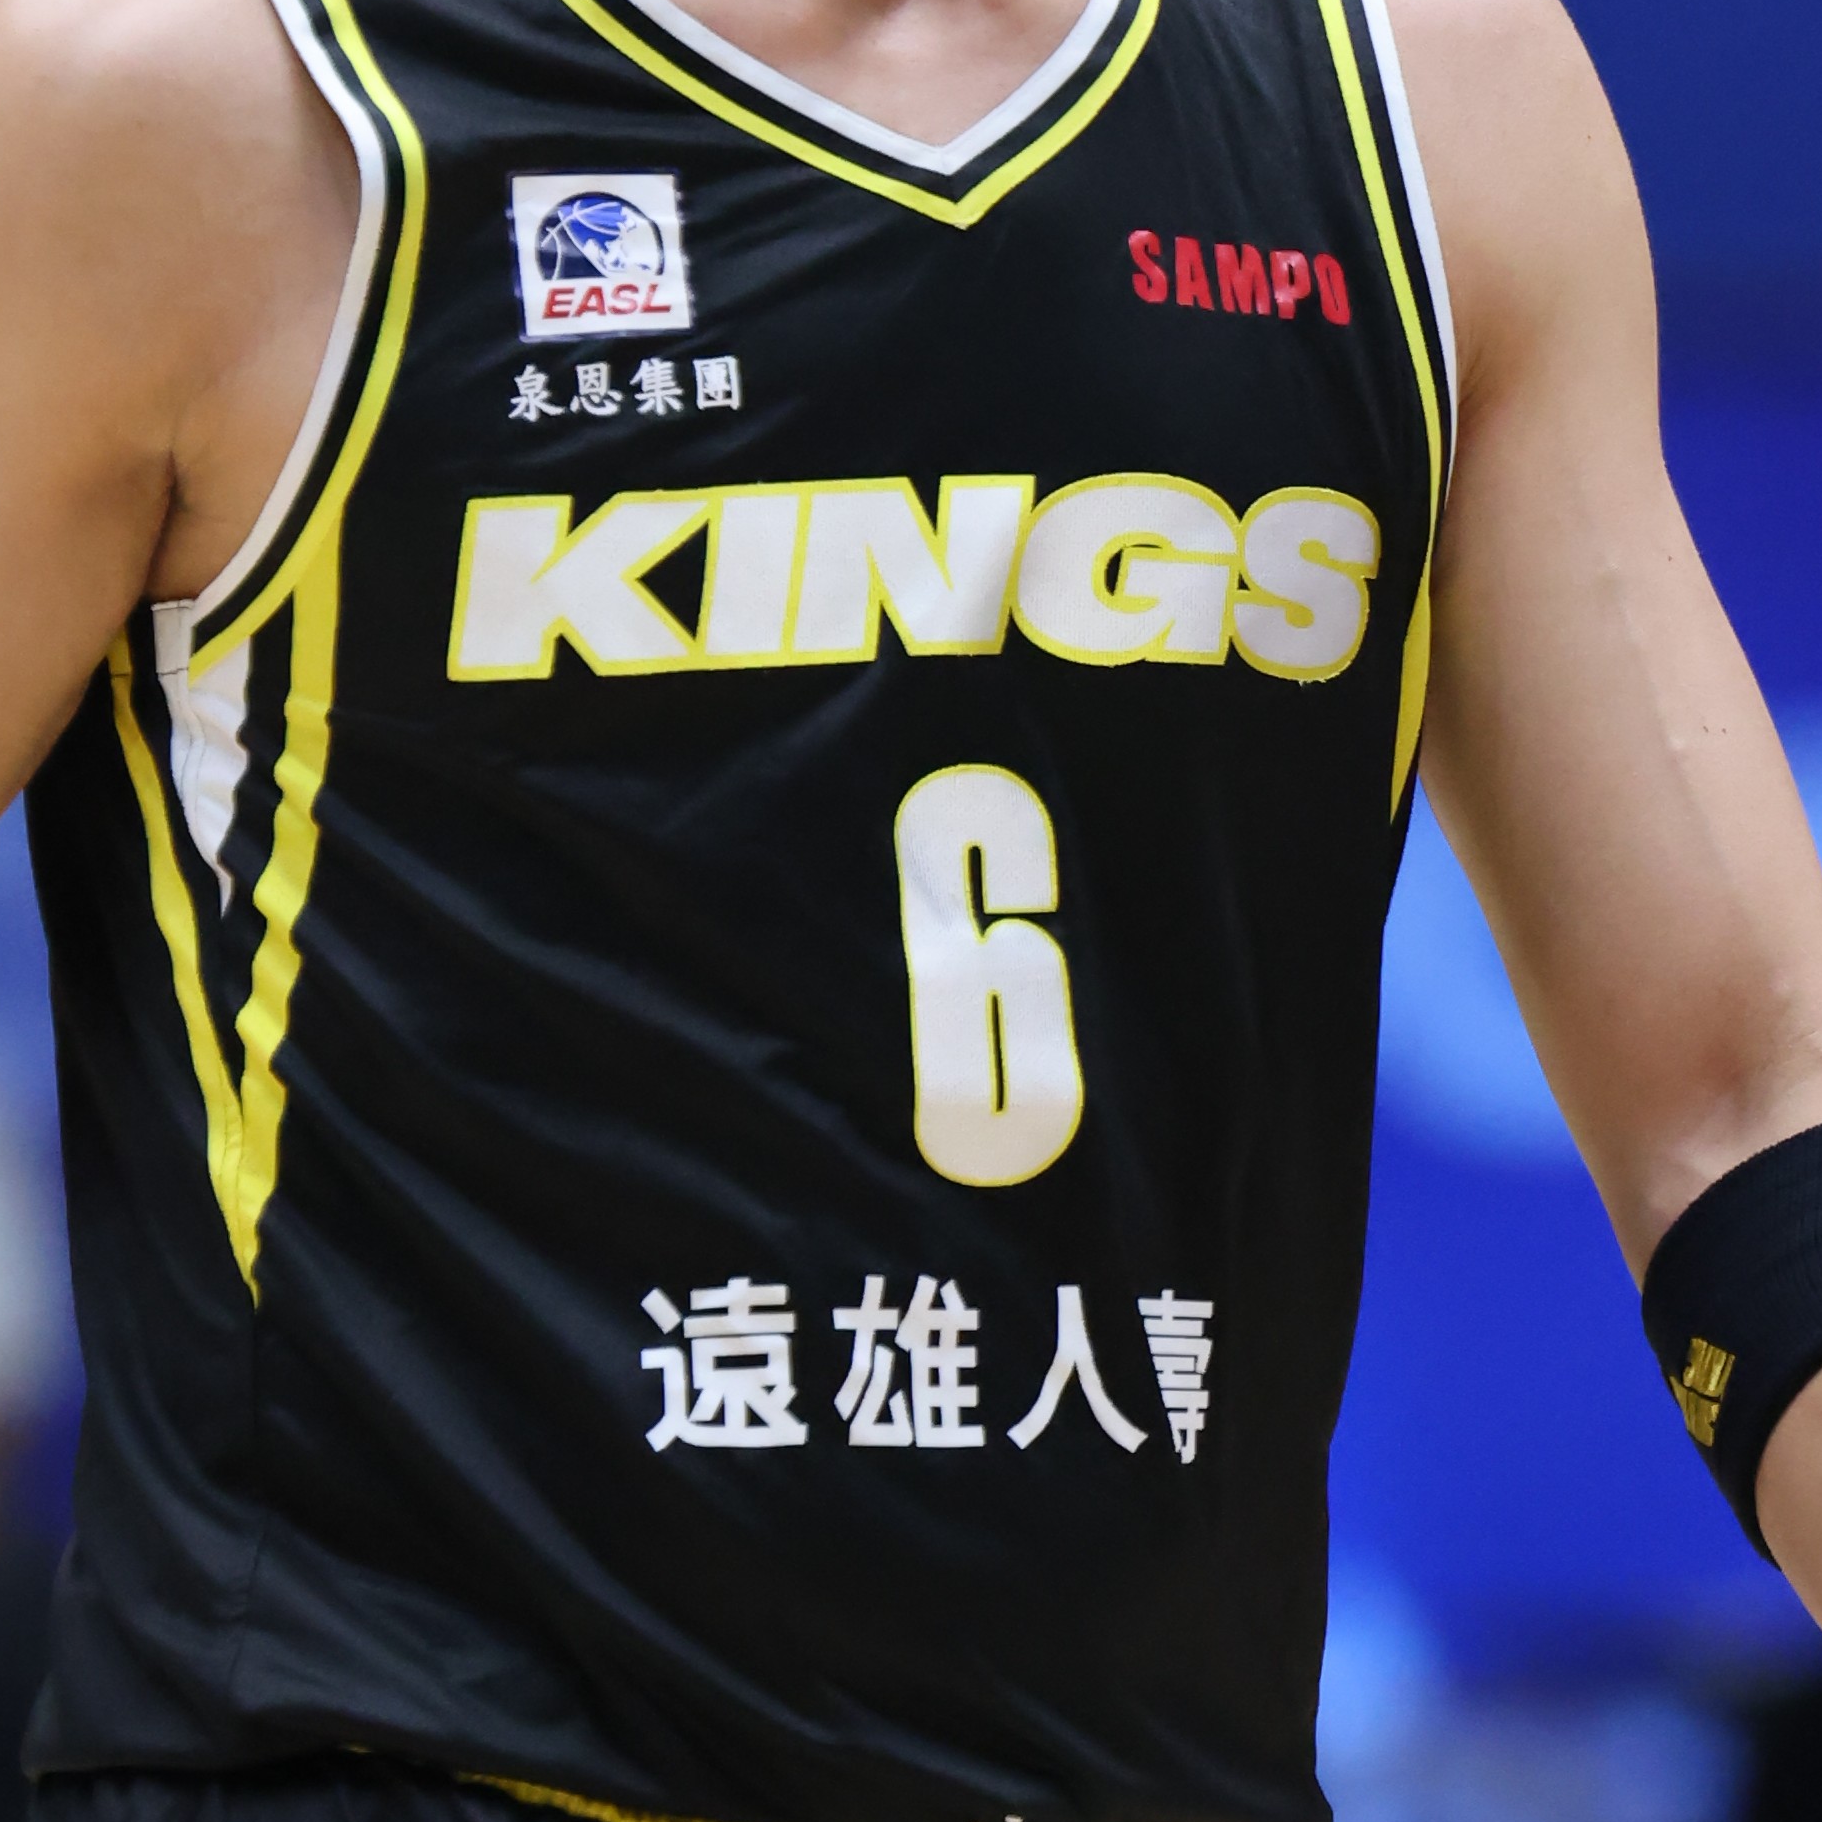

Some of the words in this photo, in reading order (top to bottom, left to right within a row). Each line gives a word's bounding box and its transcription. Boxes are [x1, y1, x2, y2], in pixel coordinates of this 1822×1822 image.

[542, 283, 672, 320] EASL
[1128, 229, 1351, 326] SAMPO
[508, 355, 742, 423] 泉恩集團
[447, 472, 1381, 685] KINGS
[893, 764, 1084, 1187] 6
